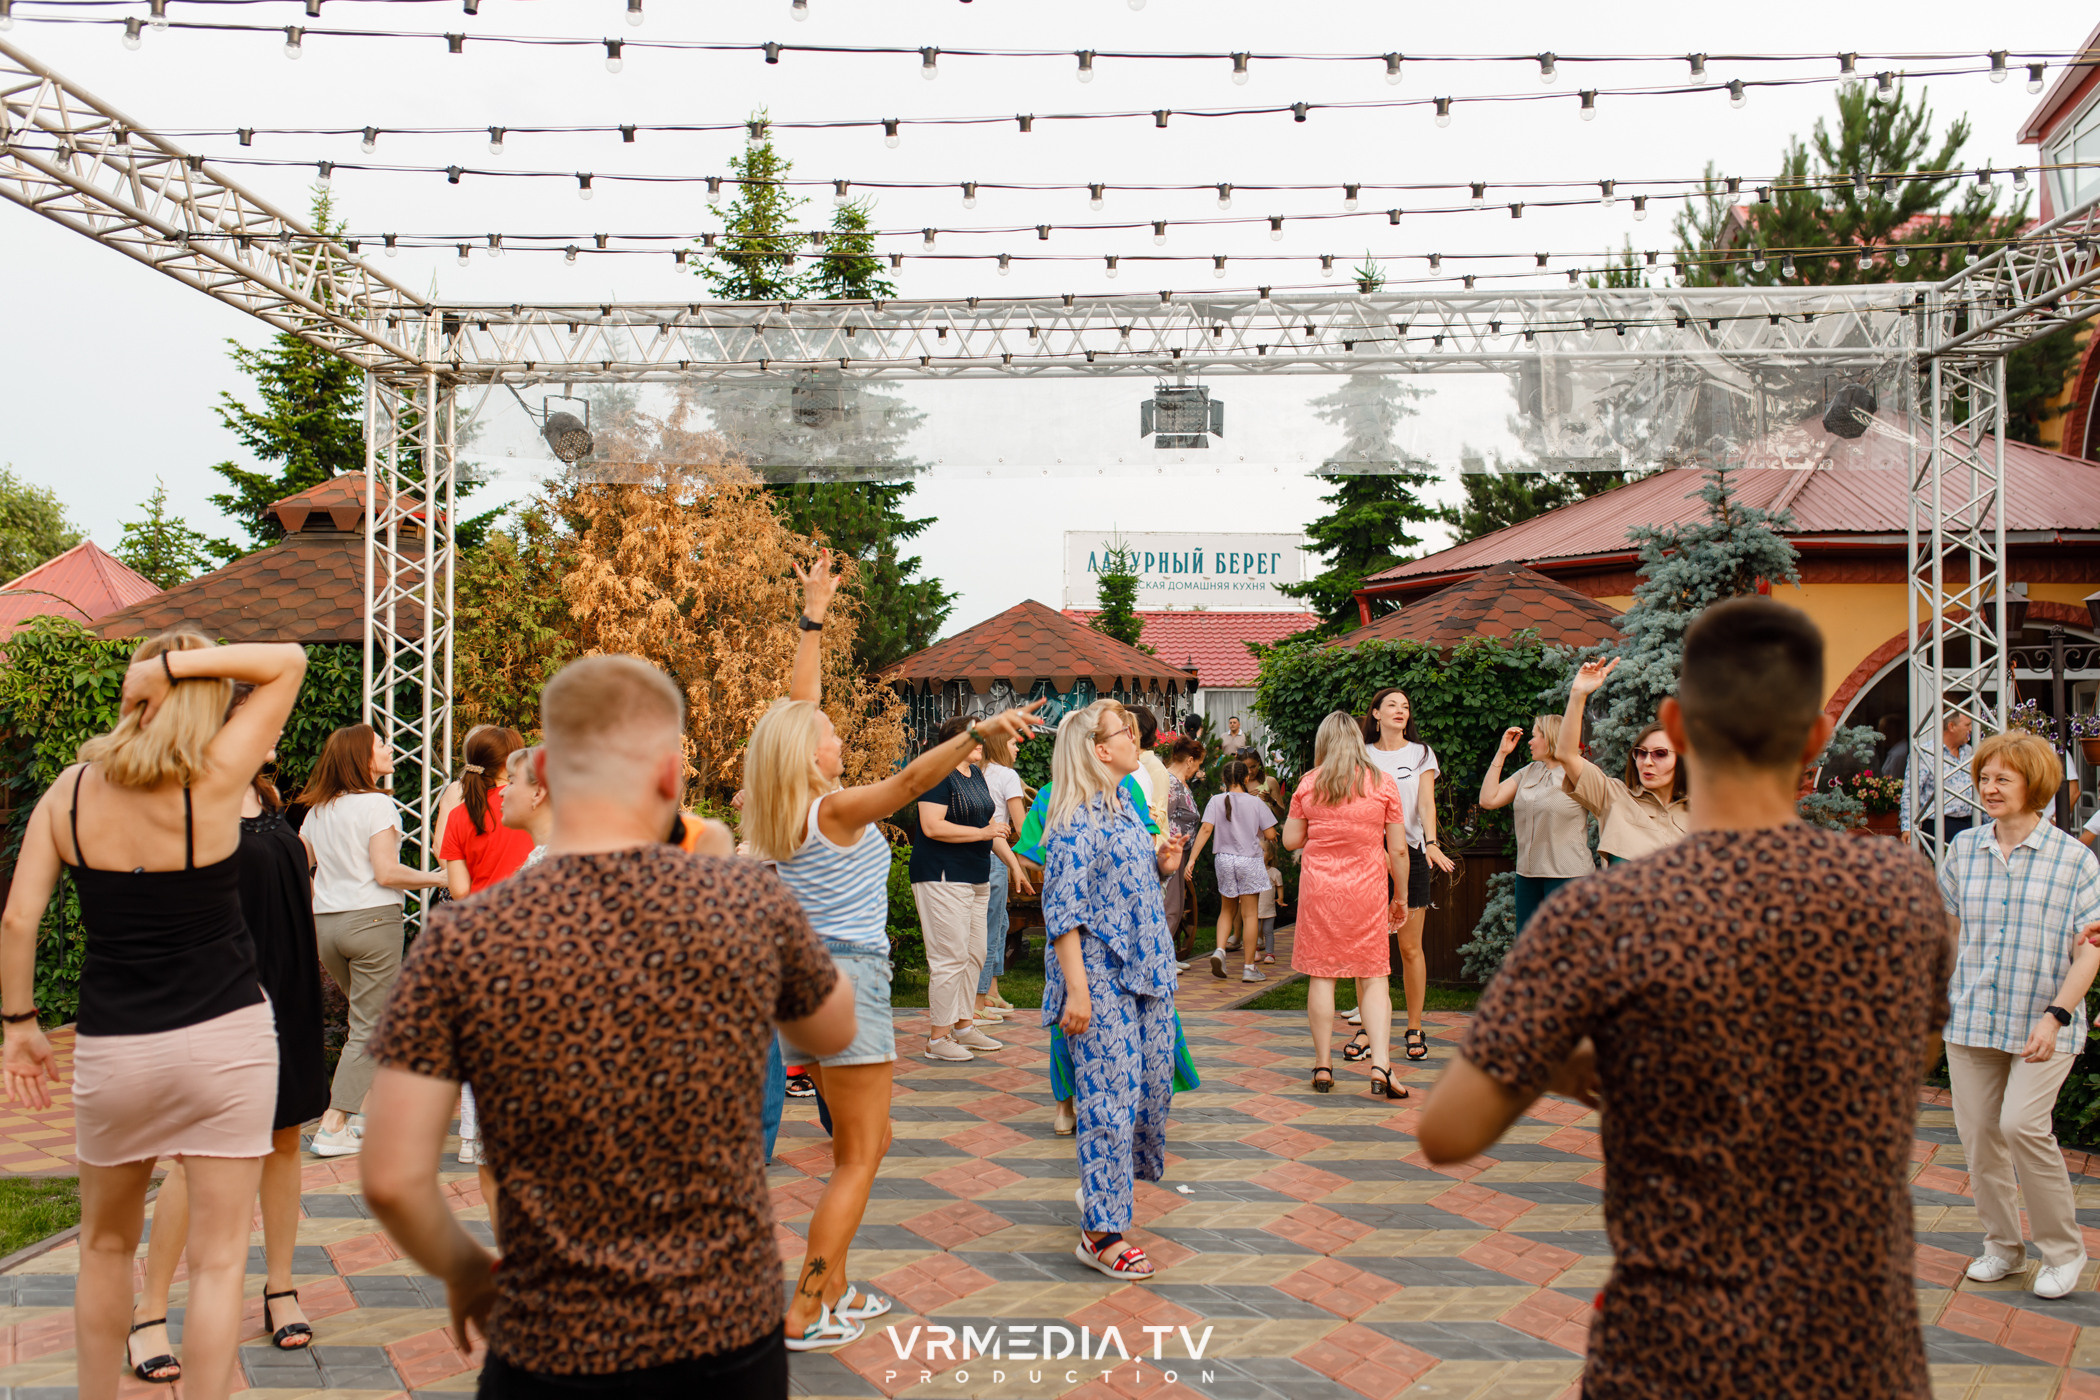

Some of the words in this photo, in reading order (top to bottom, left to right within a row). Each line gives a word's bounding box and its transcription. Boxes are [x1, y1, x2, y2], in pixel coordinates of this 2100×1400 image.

[1087, 547, 1204, 574] ЛАУРНЫЙ
[1215, 552, 1282, 574] БЕРЕГ
[1168, 581, 1230, 591] ДОМАШНЯЯ
[1233, 582, 1266, 591] КУХНЯ
